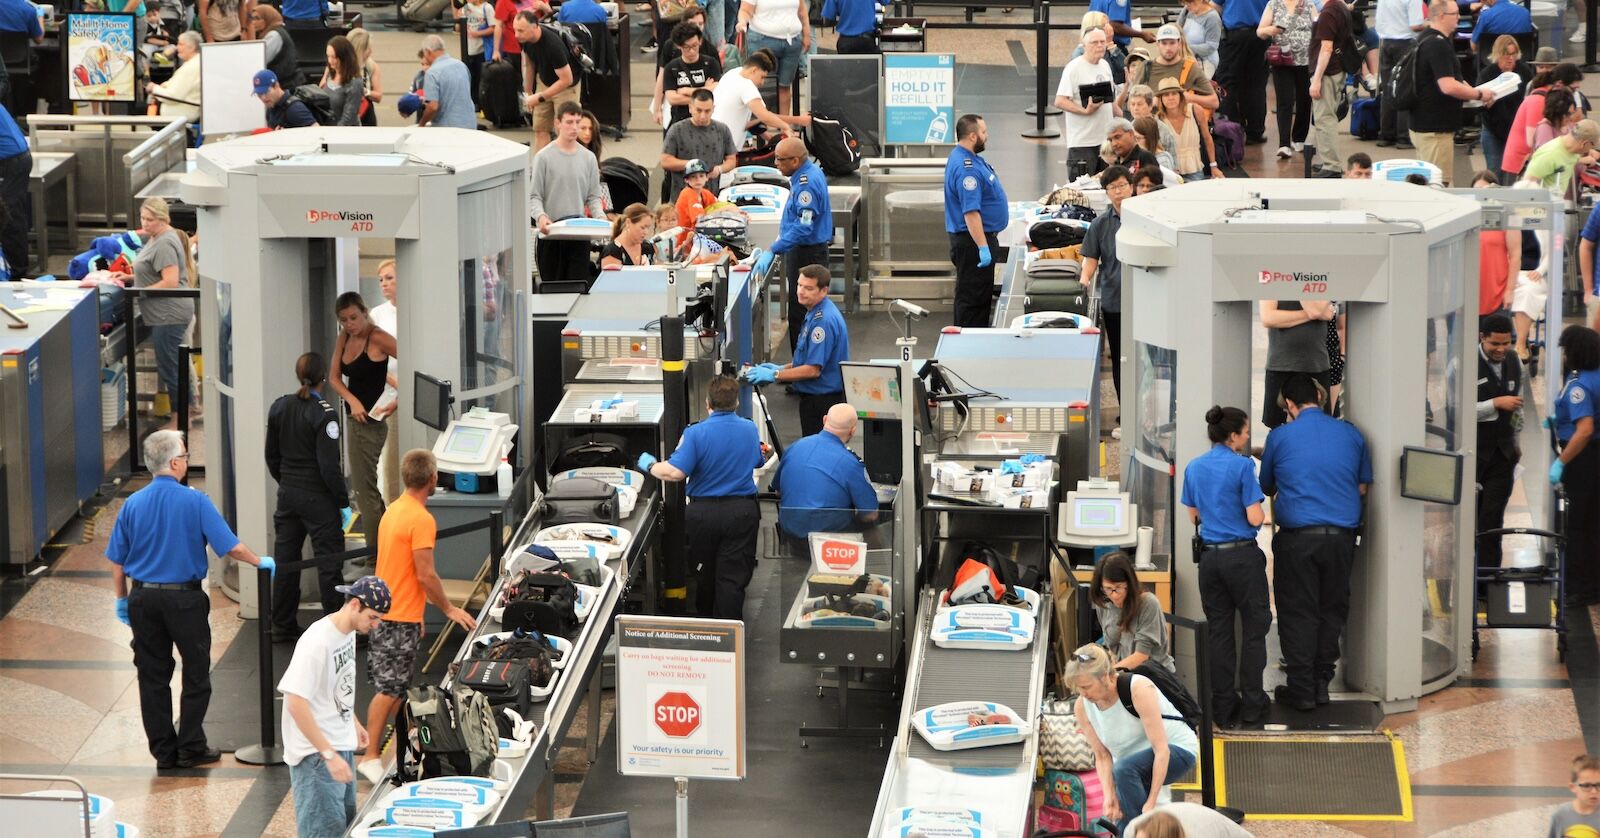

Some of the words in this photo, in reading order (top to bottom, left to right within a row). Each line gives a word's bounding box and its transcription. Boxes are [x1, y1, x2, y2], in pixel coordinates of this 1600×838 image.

[72, 19, 91, 28] Mail
[92, 19, 99, 28] It
[102, 20, 128, 28] Home
[72, 29, 101, 40] Safely!
[892, 82, 930, 92] HOLD
[934, 82, 946, 92] IT
[892, 94, 932, 104] REFILL
[935, 94, 946, 104] IT
[320, 211, 373, 220] ProVision
[351, 222, 374, 231] ATD
[668, 270, 674, 284] 5
[1273, 272, 1328, 282] ProVision
[1302, 282, 1328, 292] ATD
[903, 347, 910, 362] 6
[826, 547, 856, 558] STOP
[624, 630, 646, 638] Notice
[654, 631, 688, 640] Additional
[690, 634, 721, 642] Screening
[656, 705, 698, 723] STOP
[650, 745, 672, 754] safety
[696, 748, 724, 756] priority
